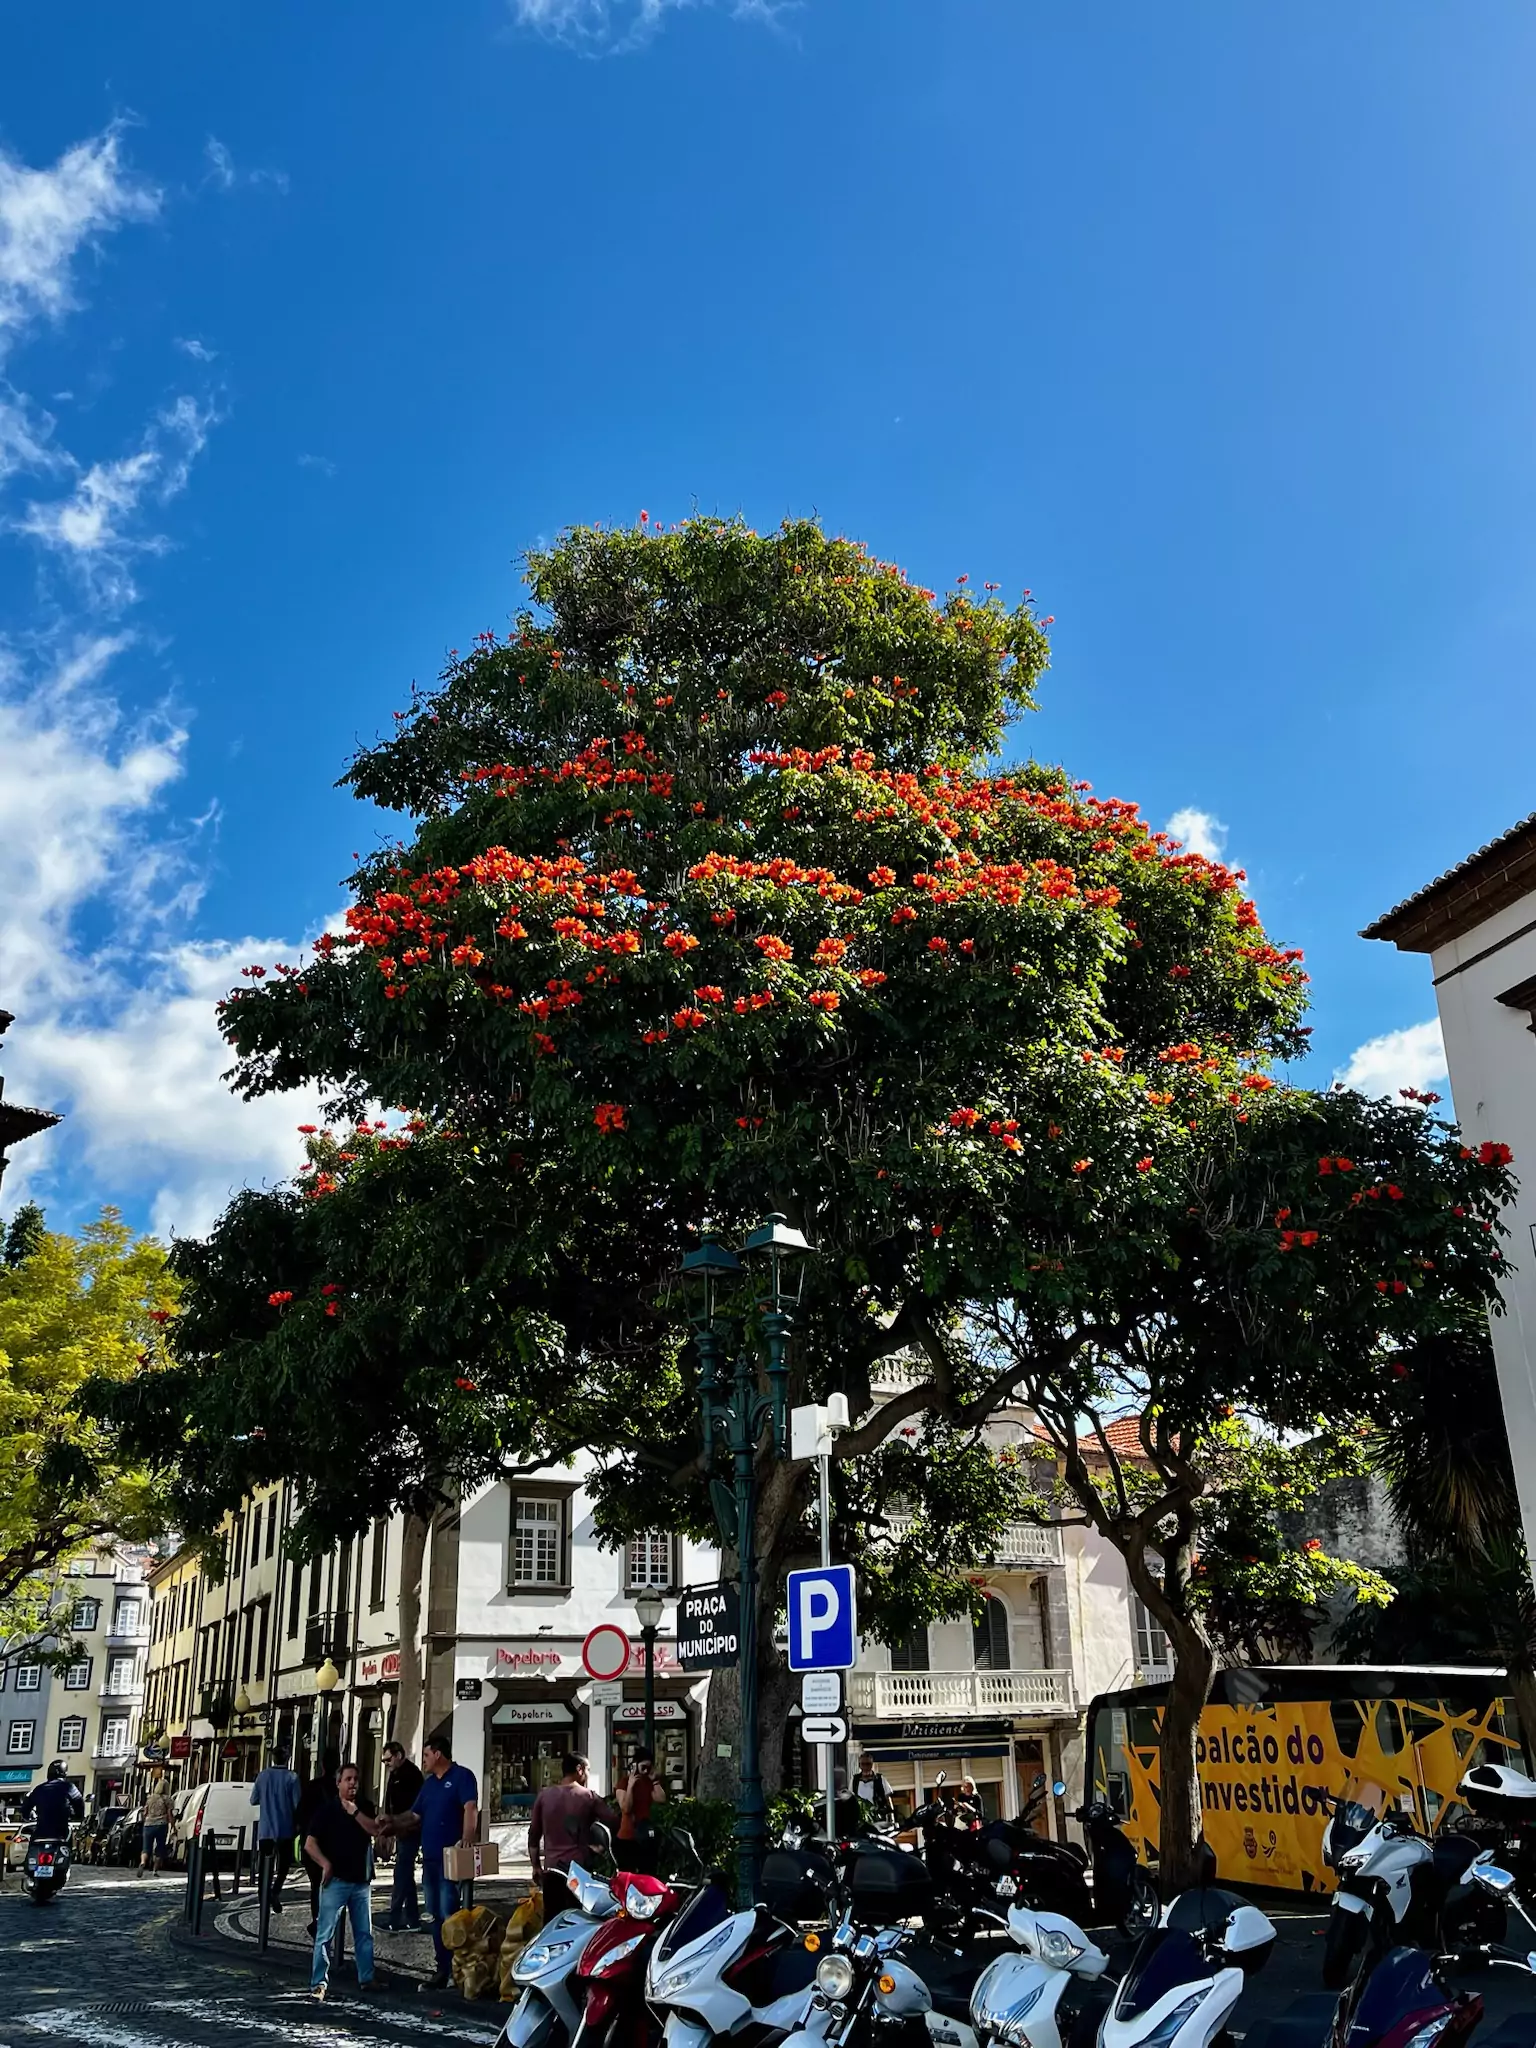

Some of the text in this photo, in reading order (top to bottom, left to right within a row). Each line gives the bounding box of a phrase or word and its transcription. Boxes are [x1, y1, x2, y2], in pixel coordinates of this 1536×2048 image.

[686, 1595, 726, 1618] PRAÇA
[700, 1619, 713, 1634] DO
[800, 1579, 839, 1659] P
[678, 1632, 737, 1658] MUNICÍPIO
[496, 1648, 561, 1670] Papelaria
[511, 1709, 553, 1721] Papelaria
[1286, 1725, 1324, 1764] do
